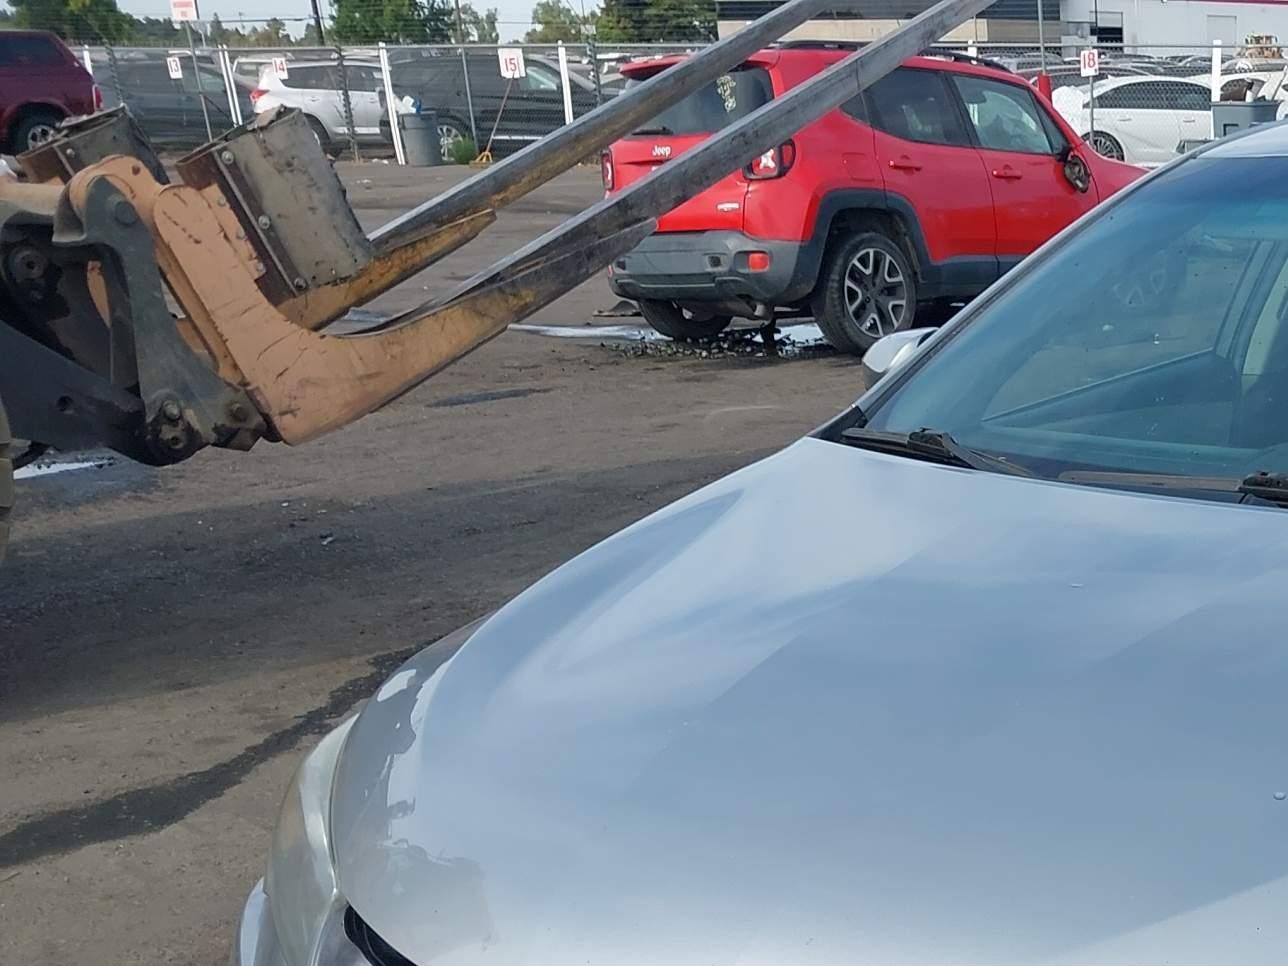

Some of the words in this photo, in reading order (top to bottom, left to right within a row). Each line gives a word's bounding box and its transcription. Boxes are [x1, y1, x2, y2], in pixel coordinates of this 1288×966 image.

[169, 59, 180, 73] 13
[504, 57, 518, 72] 15
[1083, 52, 1096, 69] 18
[652, 145, 671, 157] Jeep
